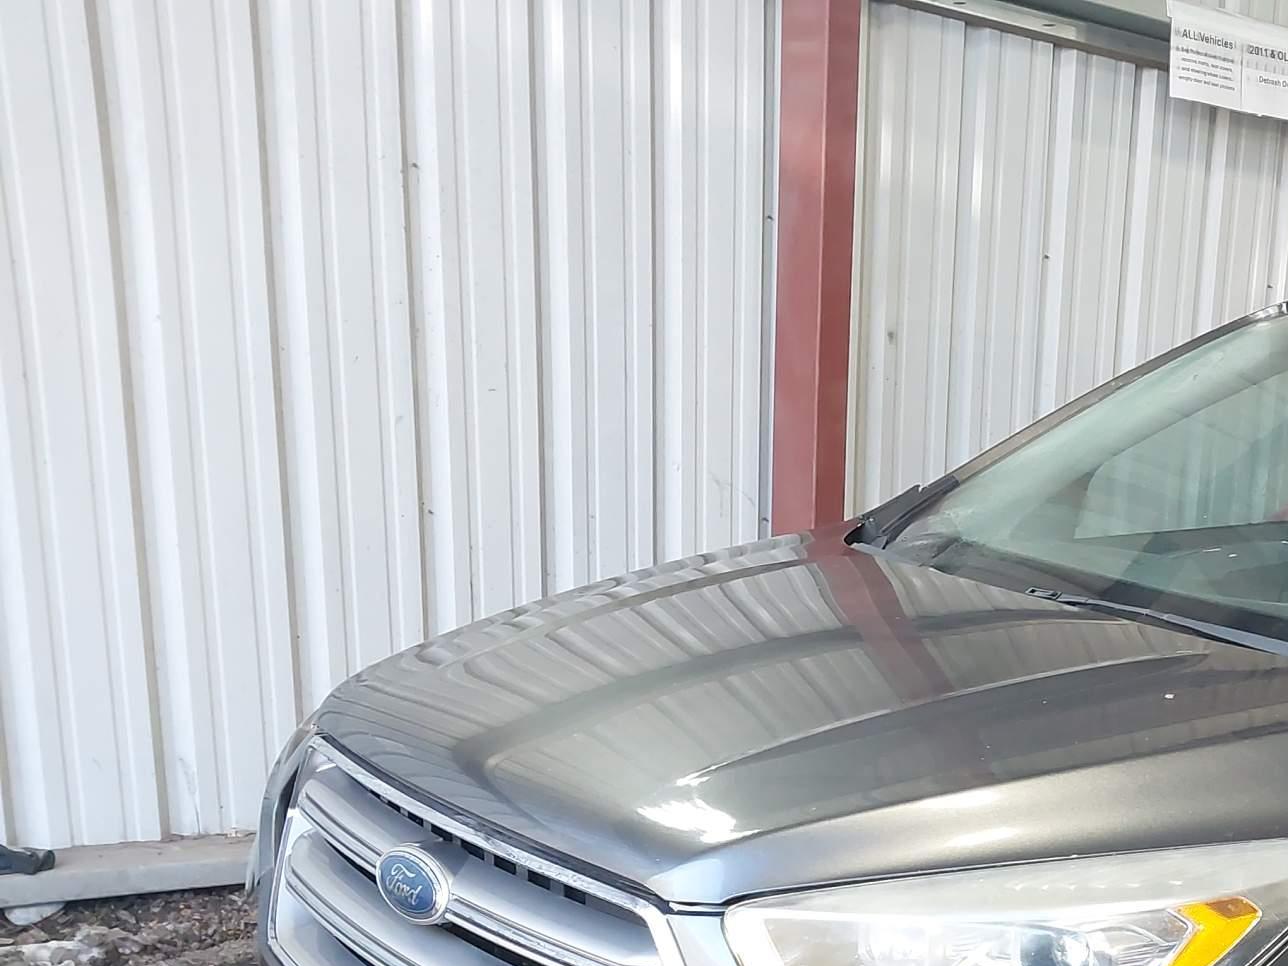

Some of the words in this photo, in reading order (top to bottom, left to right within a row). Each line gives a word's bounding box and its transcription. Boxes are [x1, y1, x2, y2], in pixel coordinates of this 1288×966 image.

[1182, 29, 1198, 41] ALL
[1199, 32, 1234, 50] Vehicles
[1248, 44, 1269, 57] 2011
[1270, 49, 1276, 59] &
[385, 863, 423, 906] Ford
